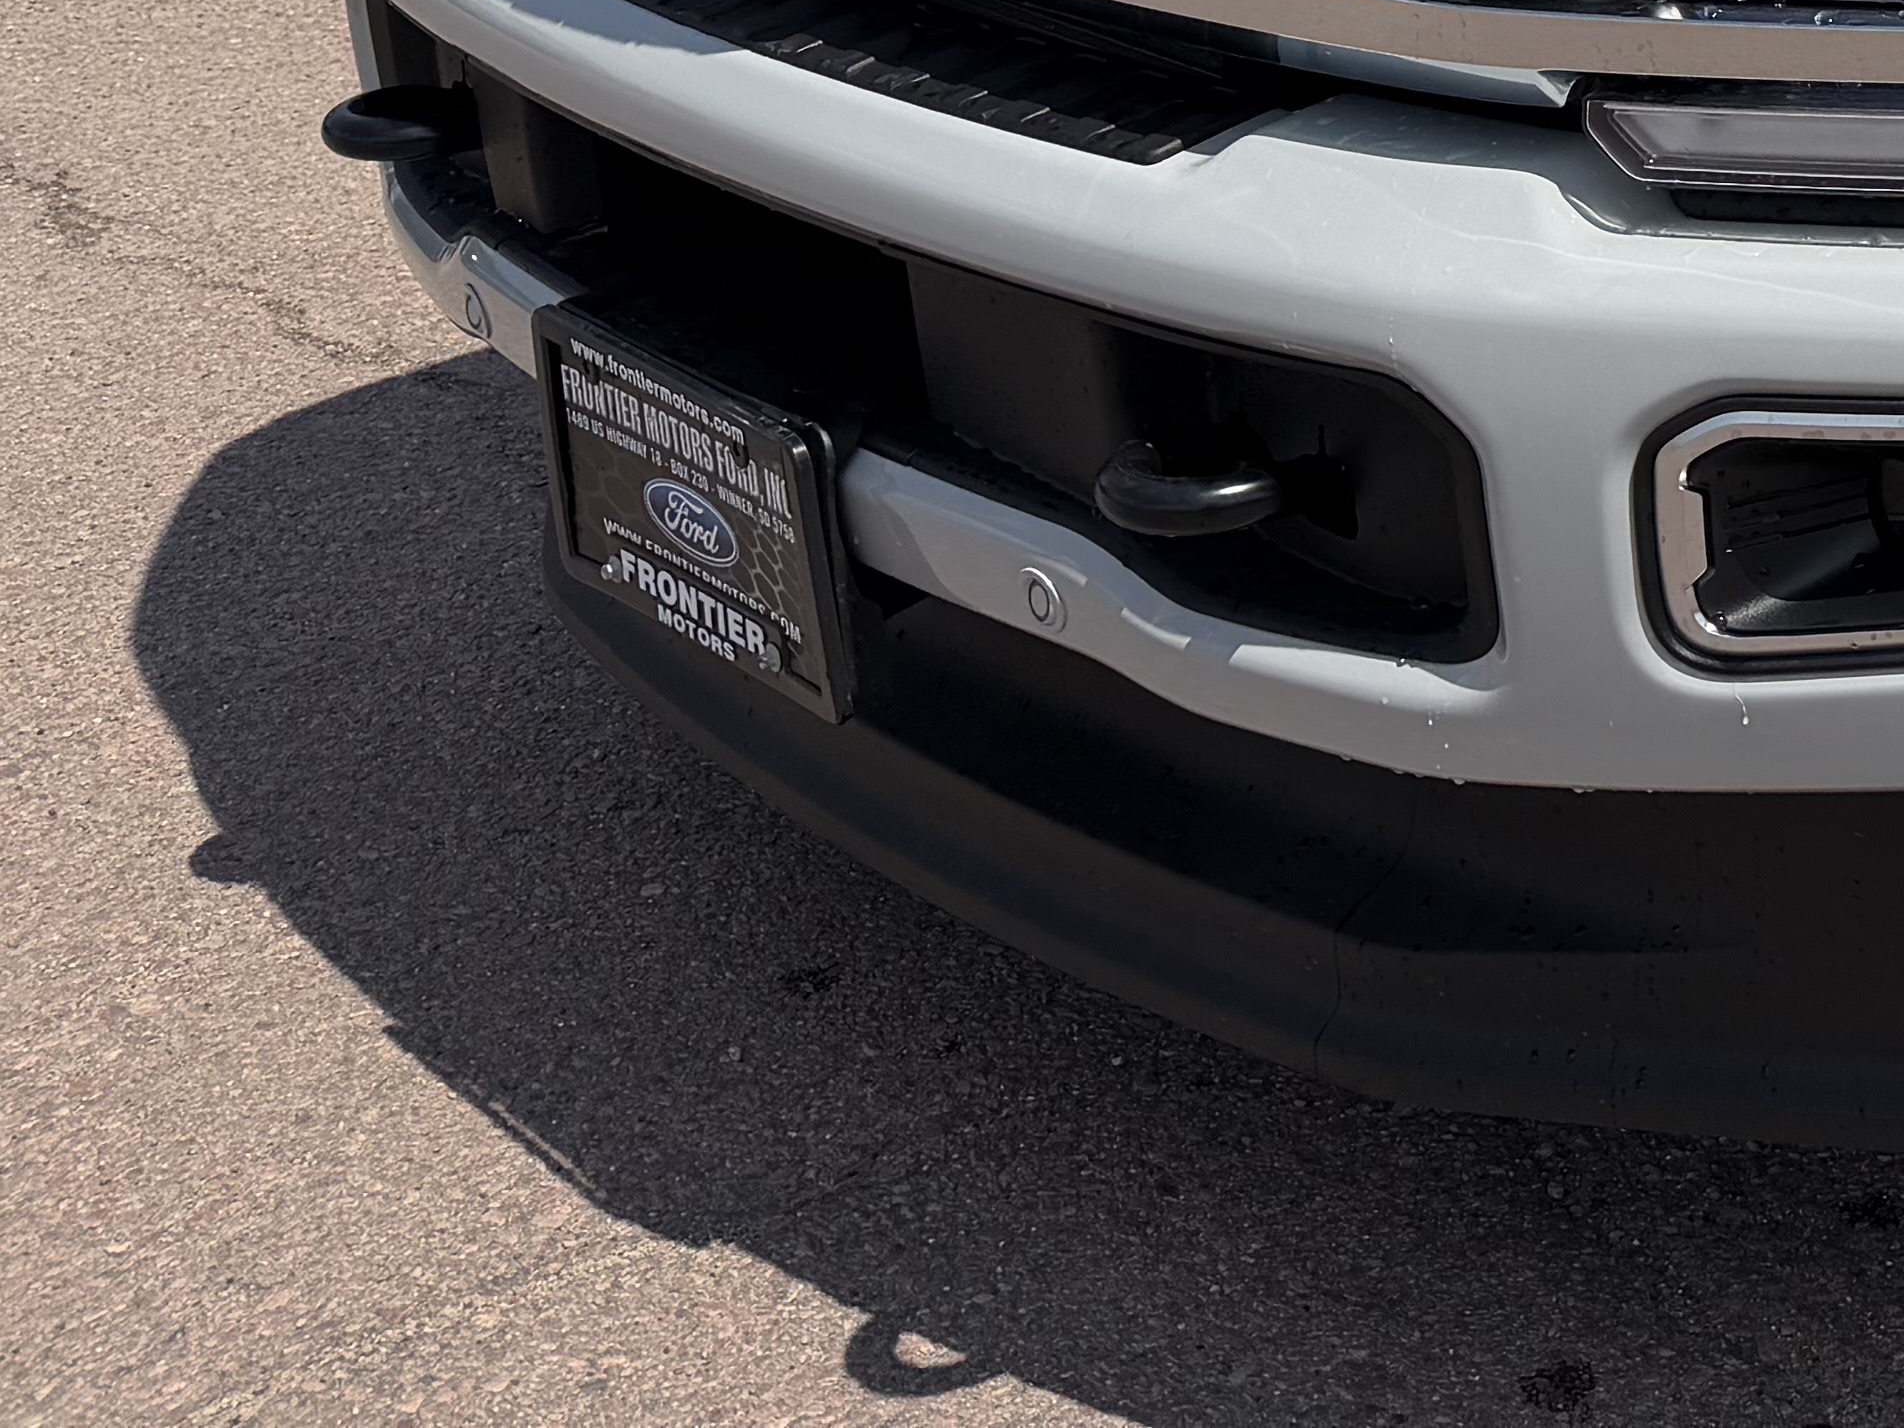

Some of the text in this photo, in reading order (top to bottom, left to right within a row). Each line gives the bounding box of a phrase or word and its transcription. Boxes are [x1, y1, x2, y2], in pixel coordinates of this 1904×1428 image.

[569, 337, 745, 446] www.frontiermotors.com
[605, 425, 648, 459] HIGHWAY
[670, 458, 690, 483] BOX
[643, 402, 714, 473] MOTORS
[664, 491, 720, 554] Ford
[619, 547, 767, 656] FRONTIER
[656, 604, 737, 662] MOTORS
